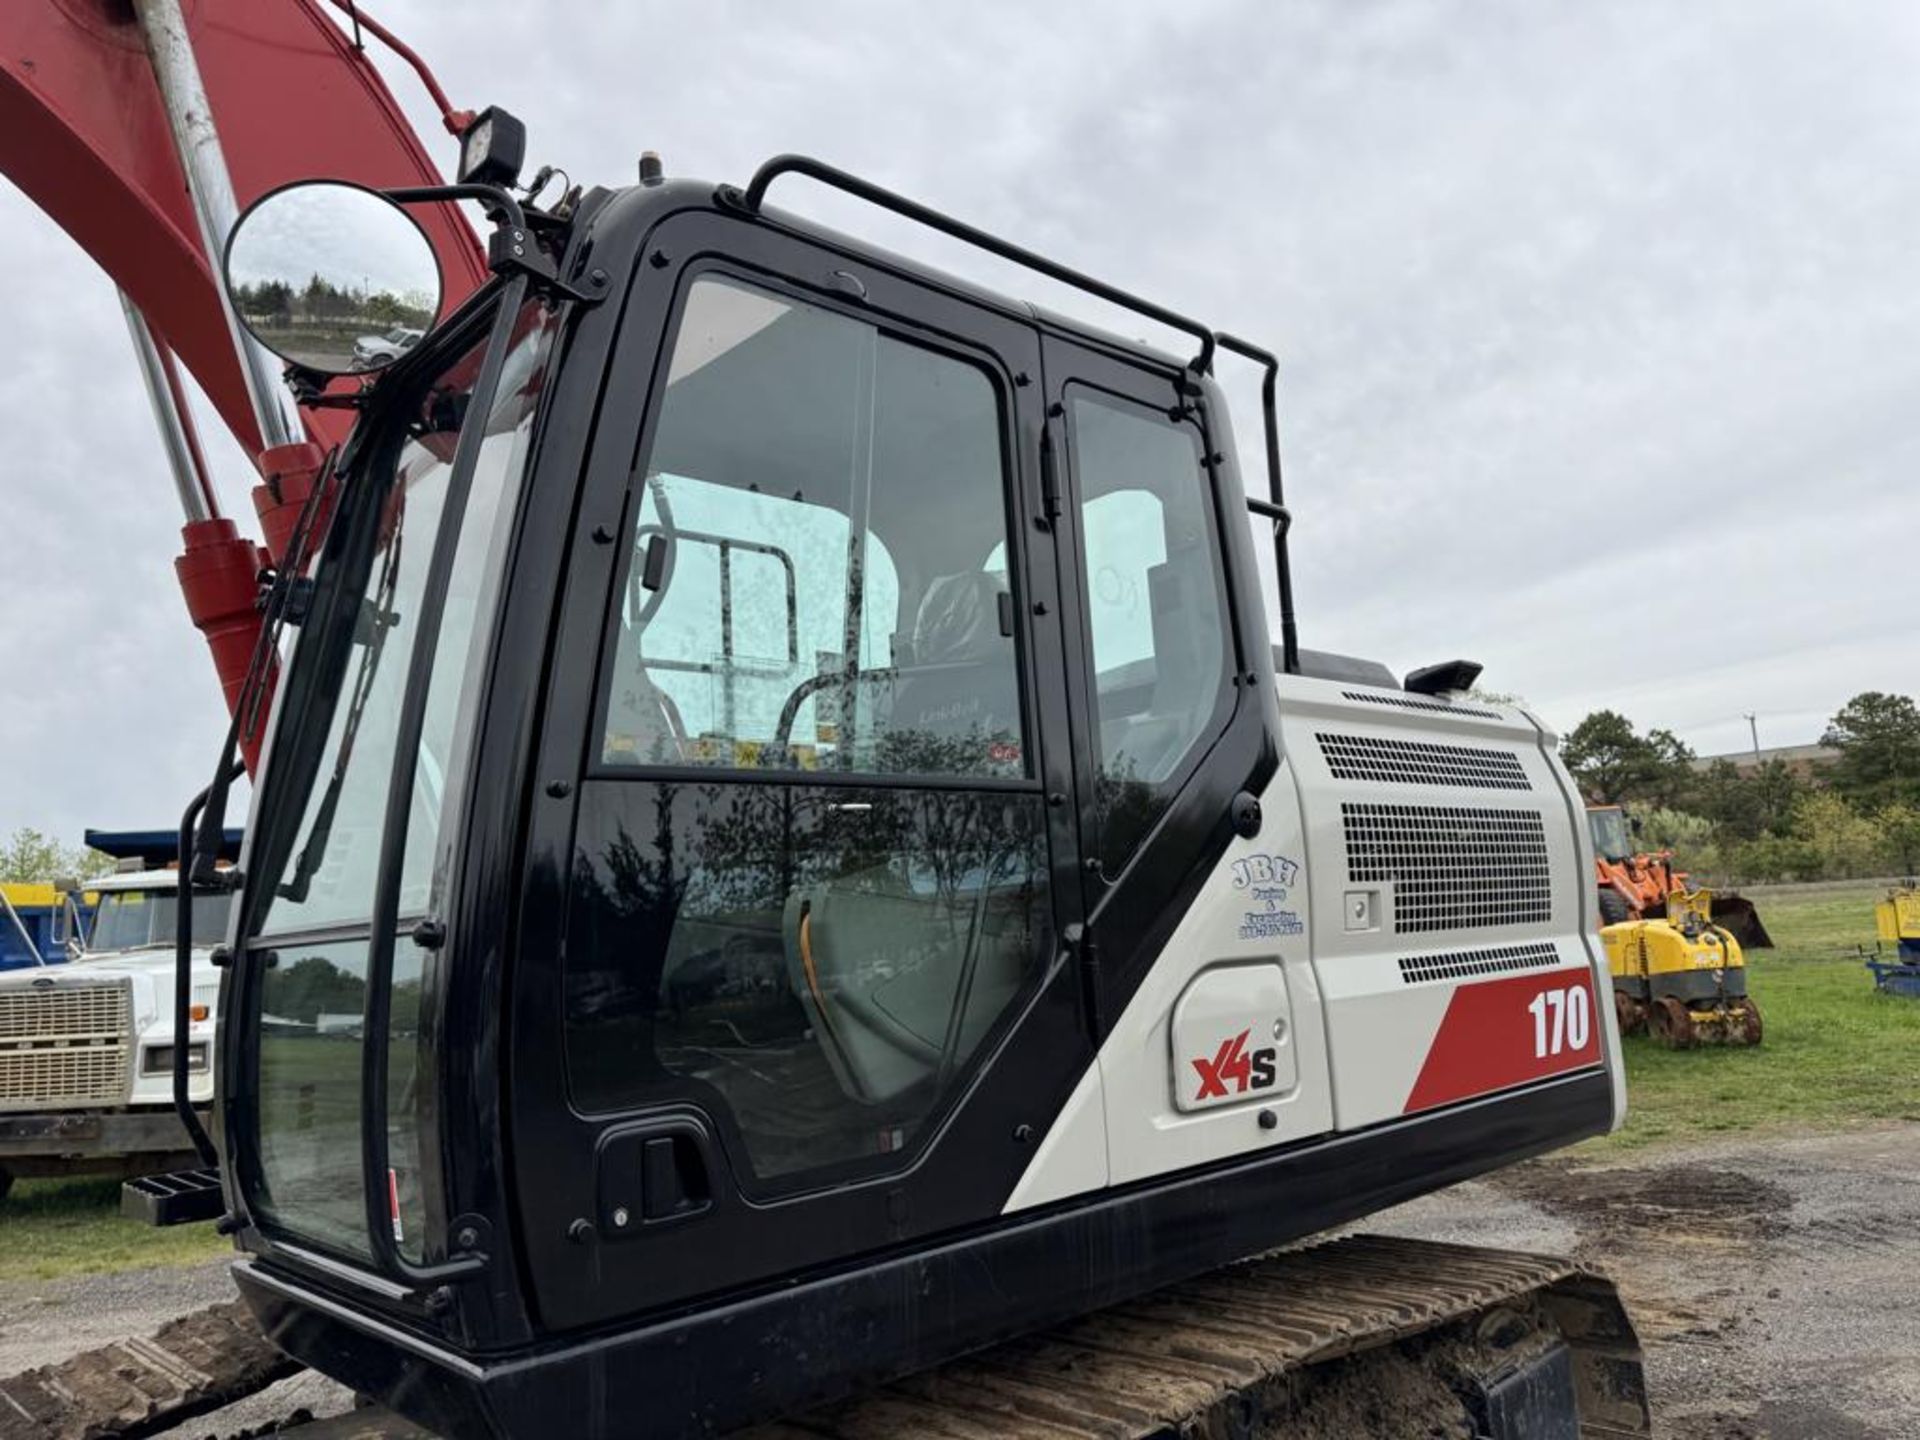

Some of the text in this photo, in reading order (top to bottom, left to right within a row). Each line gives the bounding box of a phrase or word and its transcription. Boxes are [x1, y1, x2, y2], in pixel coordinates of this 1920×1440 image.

[1231, 854, 1299, 890] JBH
[1528, 984, 1589, 1058] 170
[1191, 1027, 1276, 1101] X4S
